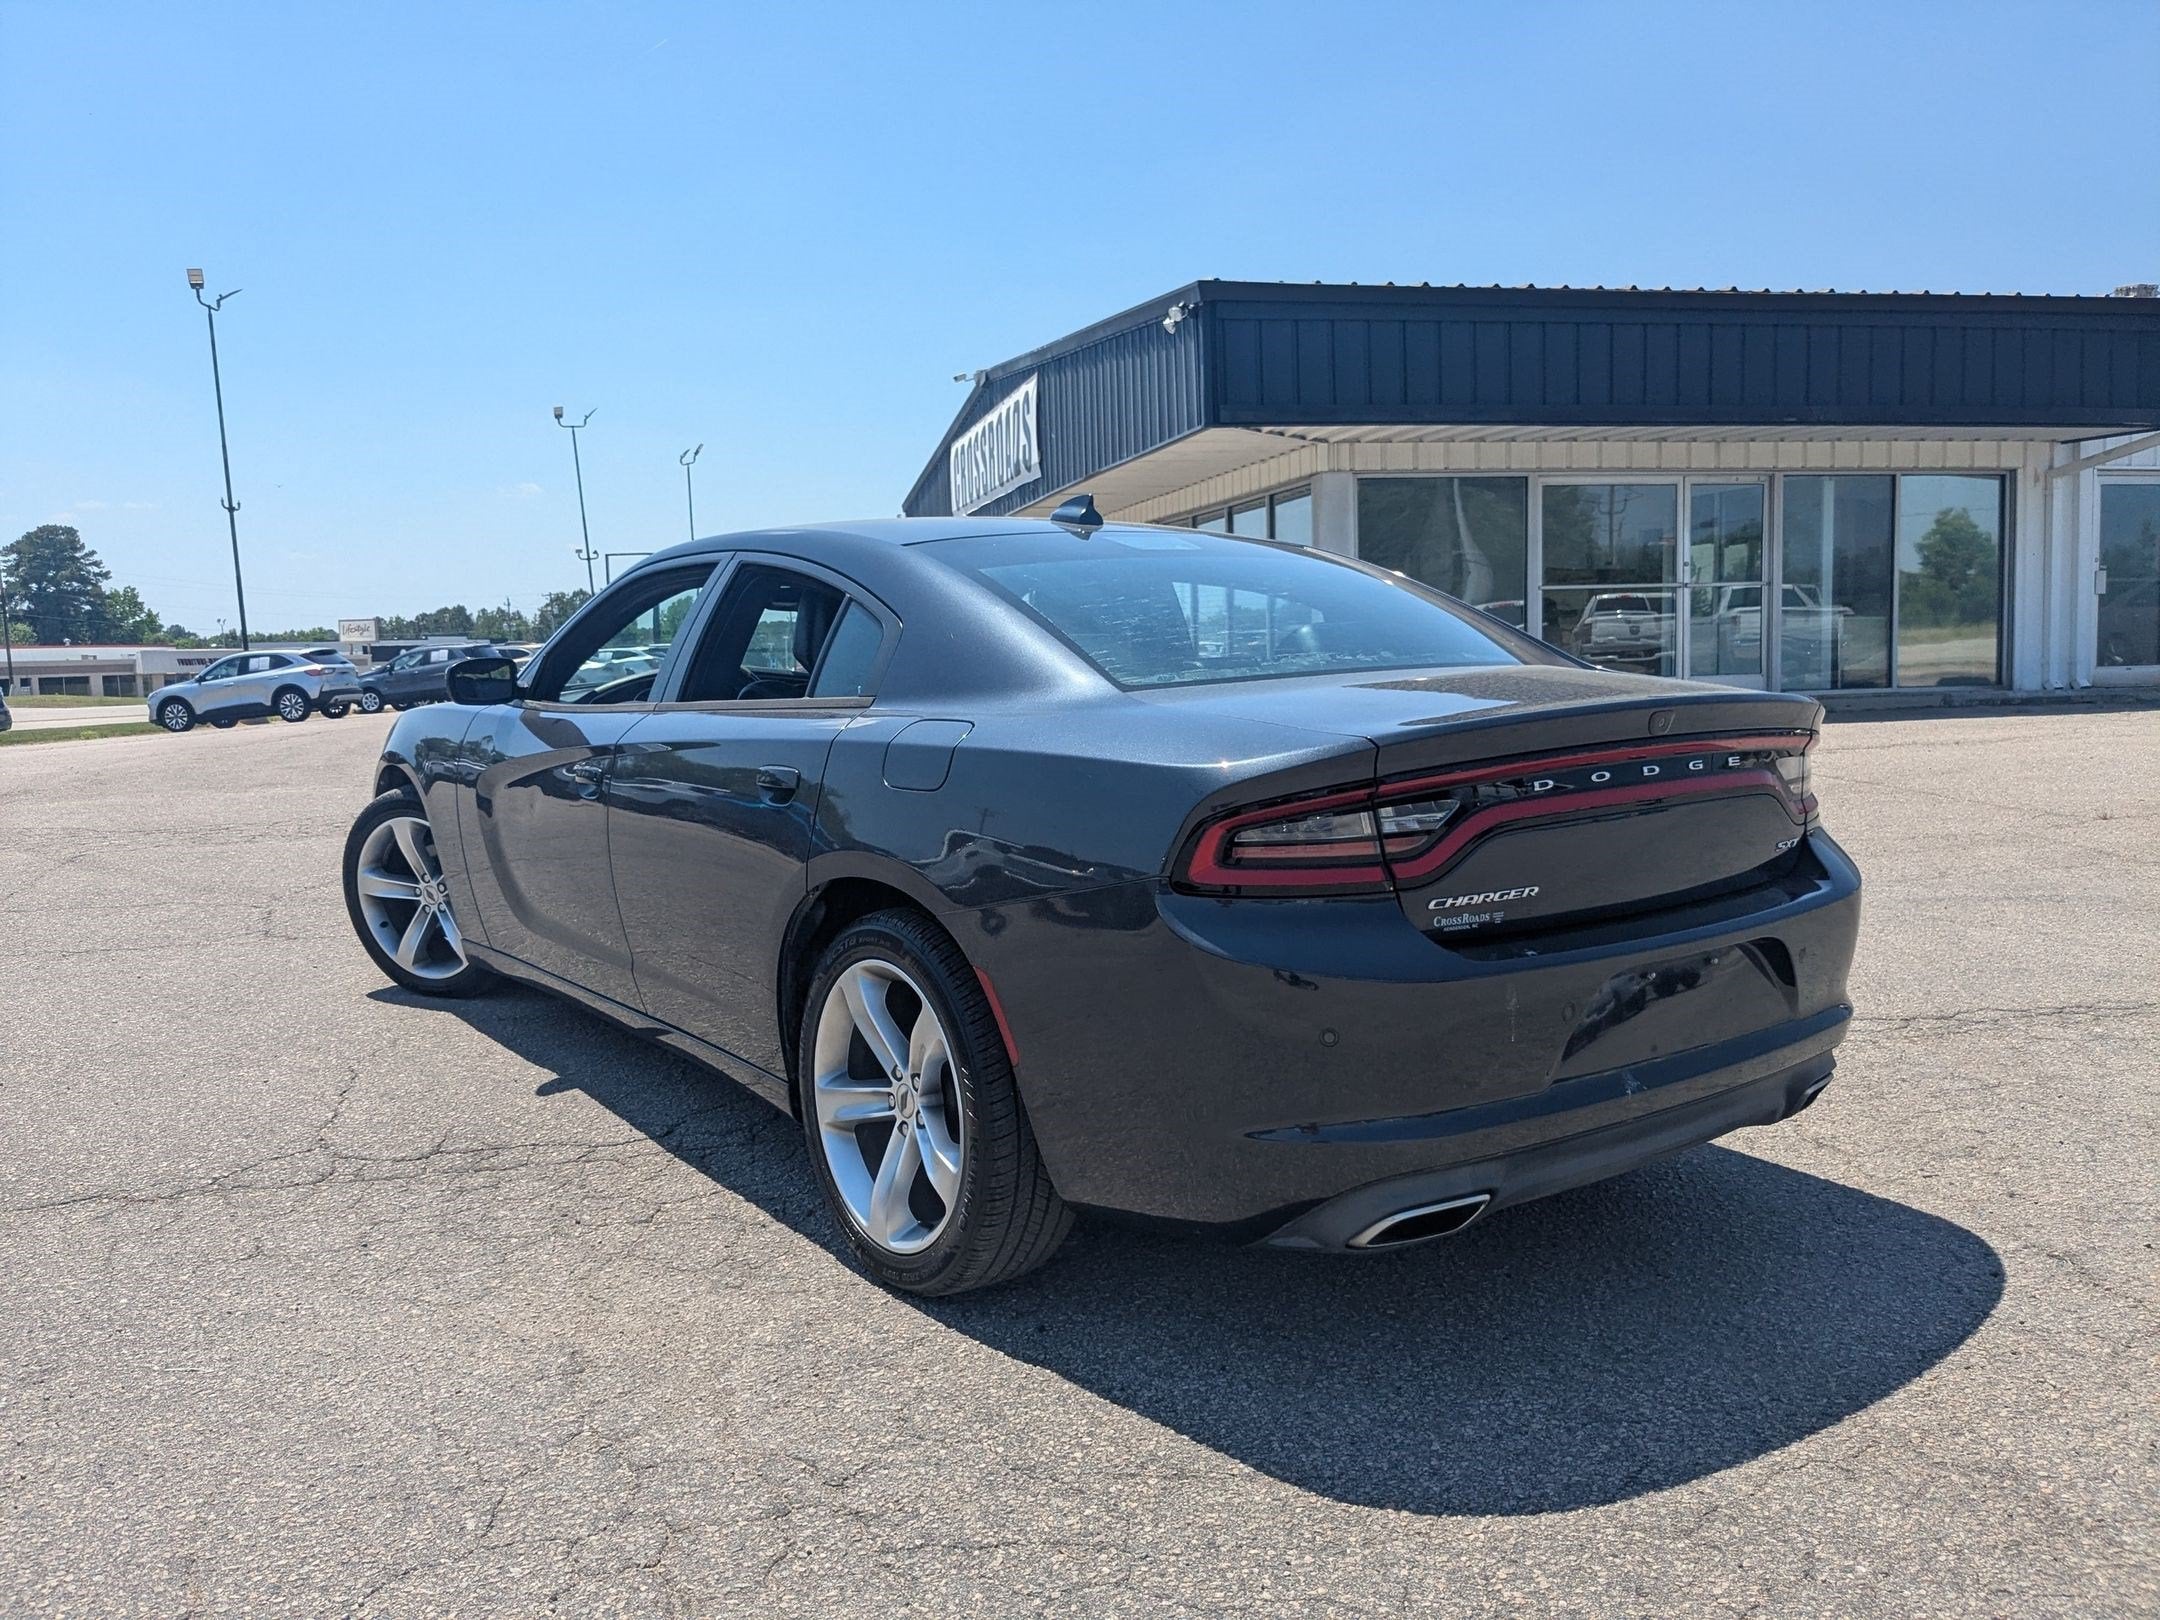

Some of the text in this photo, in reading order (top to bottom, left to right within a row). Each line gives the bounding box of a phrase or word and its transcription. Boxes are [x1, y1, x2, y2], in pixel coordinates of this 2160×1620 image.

[953, 389, 1033, 512] CROSSROADS
[1533, 755, 1741, 793] DODGE
[1777, 837, 1800, 849] SXT
[1427, 886, 1540, 910] CHARGER
